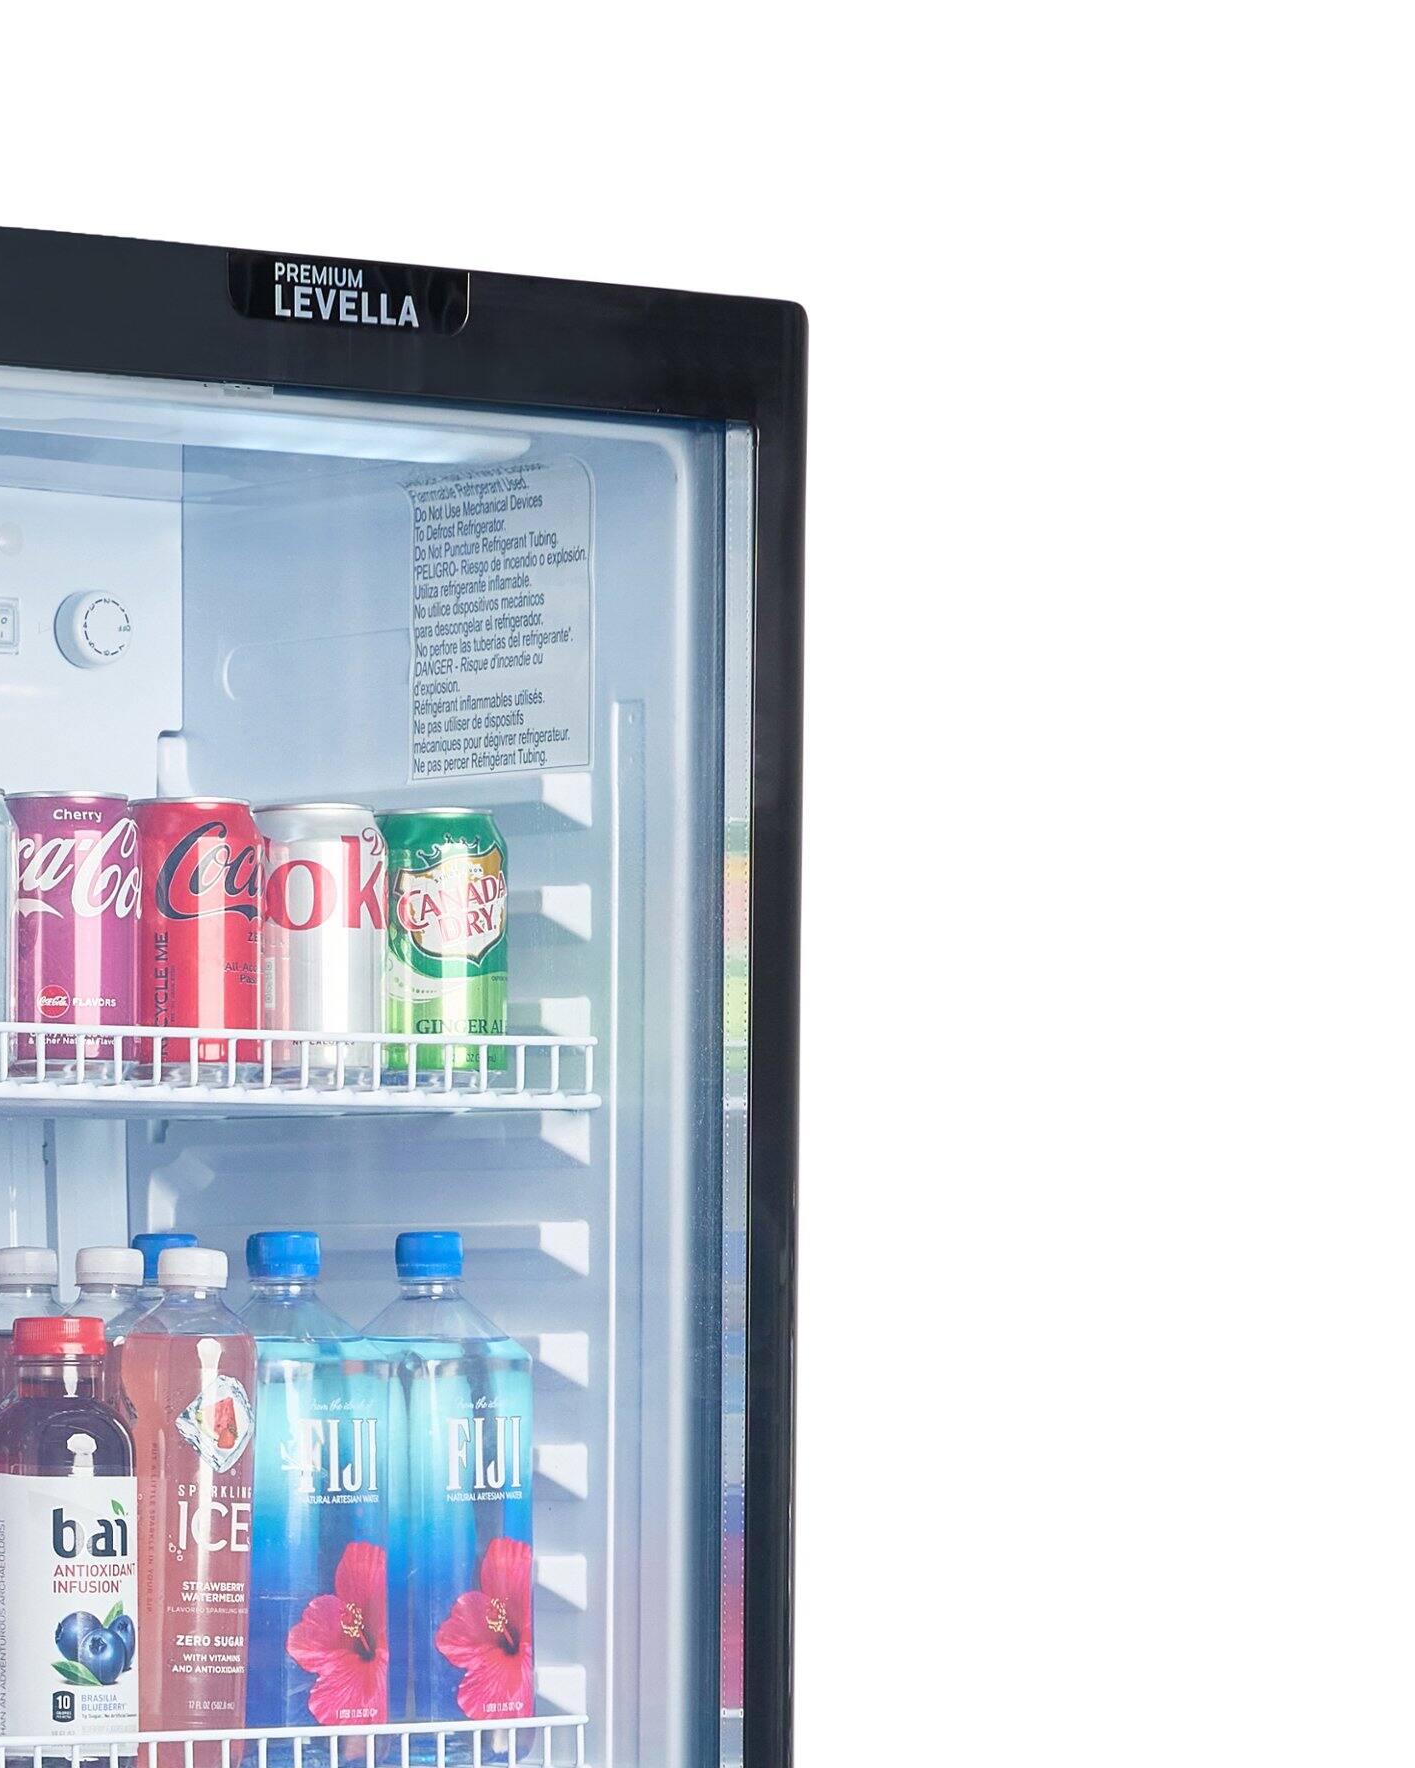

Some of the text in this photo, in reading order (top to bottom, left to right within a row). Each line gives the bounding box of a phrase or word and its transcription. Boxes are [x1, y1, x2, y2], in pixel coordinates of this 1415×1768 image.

[274, 262, 363, 289] PREMIUM
[275, 284, 419, 328] LEVELLA
[455, 478, 504, 499] Refrigerant
[504, 476, 529, 491] Used.
[416, 493, 543, 523] Do Not Use Mechanical Devices
[415, 518, 506, 541] To Defrost Refrigerator.
[415, 531, 558, 561] Do Not Puncture Refrigerant Tubing.
[461, 559, 488, 577] Riesgo
[491, 557, 501, 572] de
[504, 553, 537, 570] incendio
[540, 554, 545, 566] o
[547, 546, 587, 570] explosión.
[415, 572, 532, 601] Utiliza refrigerante inflamable.
[415, 592, 545, 619] No utilice dispositivos mecánicos
[415, 613, 543, 639] para descongelar el refrigerador.
[416, 642, 427, 658] No
[430, 638, 458, 659] perfore
[460, 638, 472, 654] las
[474, 636, 506, 652] tuberías
[508, 634, 520, 648] del
[415, 651, 544, 677] DANGER Risque d'incendie ou
[414, 679, 460, 697] d'explosion.
[414, 689, 545, 717] Réfrigérant inflammables utilisés.
[414, 709, 524, 736] Ne pas utiliser de dispositifs
[414, 728, 570, 755] mécaniques pour dégivrer refrigerateur.
[414, 748, 547, 775] Ne pas percer Réfrigérant Tubing.
[53, 809, 102, 822] Cherry
[397, 870, 508, 932] CANADA
[155, 932, 169, 961] ME
[73, 998, 116, 1007] FLAVORS
[416, 1019, 487, 1034] GINGER
[298, 1419, 378, 1493] FIJI
[447, 1416, 521, 1490] FIJI
[178, 1485, 251, 1498] SPRKLING
[332, 1495, 361, 1504] ARTESIAN
[447, 1492, 476, 1501] NATURAL
[476, 1492, 505, 1500] ARTESIAN
[53, 1499, 128, 1558] bai
[178, 1501, 251, 1551] ICE
[54, 1563, 135, 1577] ANTIOXIDANT
[54, 1580, 119, 1593] INFUSION
[182, 1593, 244, 1602] WATERMELON
[183, 1581, 244, 1591] STRAWBERRY
[0, 1608, 7, 1689] ADVENTUROUS
[176, 1635, 243, 1647] ZERO SUGAR
[209, 1654, 240, 1662] VITAMINS
[0, 1693, 7, 1707] AN
[56, 1695, 70, 1709] 10
[82, 1703, 125, 1711] BLUEBERRY
